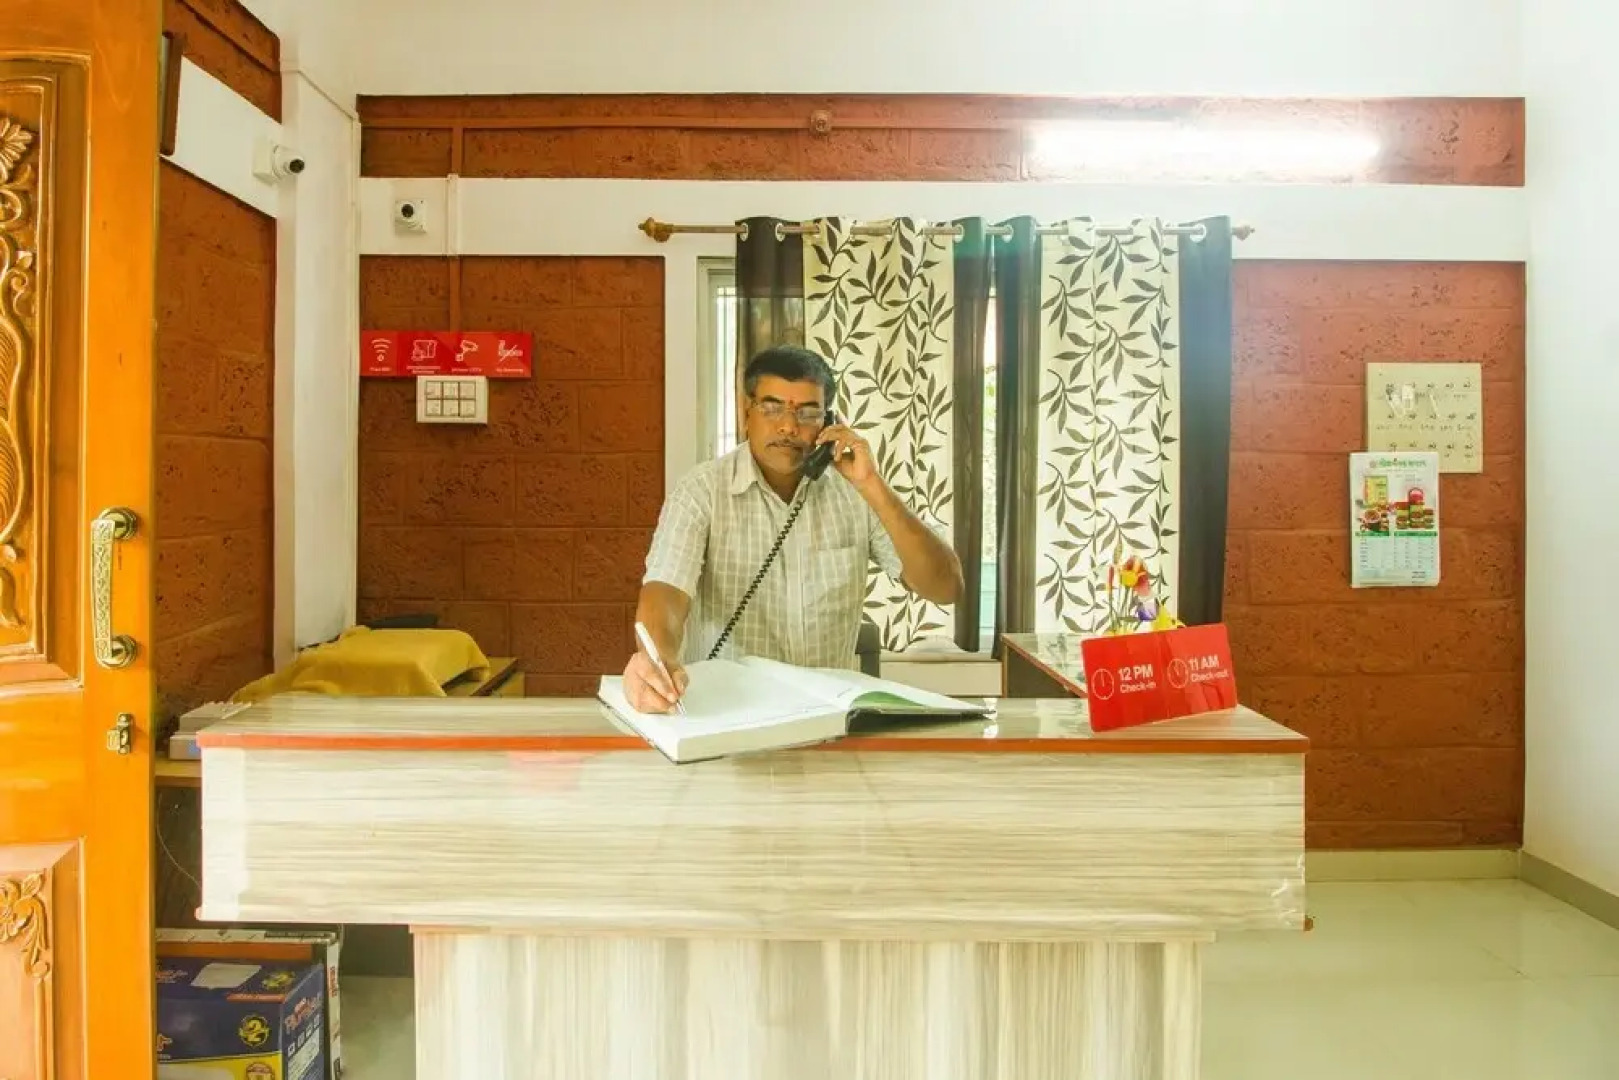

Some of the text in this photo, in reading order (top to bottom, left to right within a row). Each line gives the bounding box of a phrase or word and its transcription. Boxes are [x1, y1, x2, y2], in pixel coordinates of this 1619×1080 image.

[1188, 655, 1220, 671] 11 AM
[1118, 664, 1154, 681] 12 PM
[1190, 669, 1229, 683] Check-out
[1120, 681, 1157, 694] Check-in
